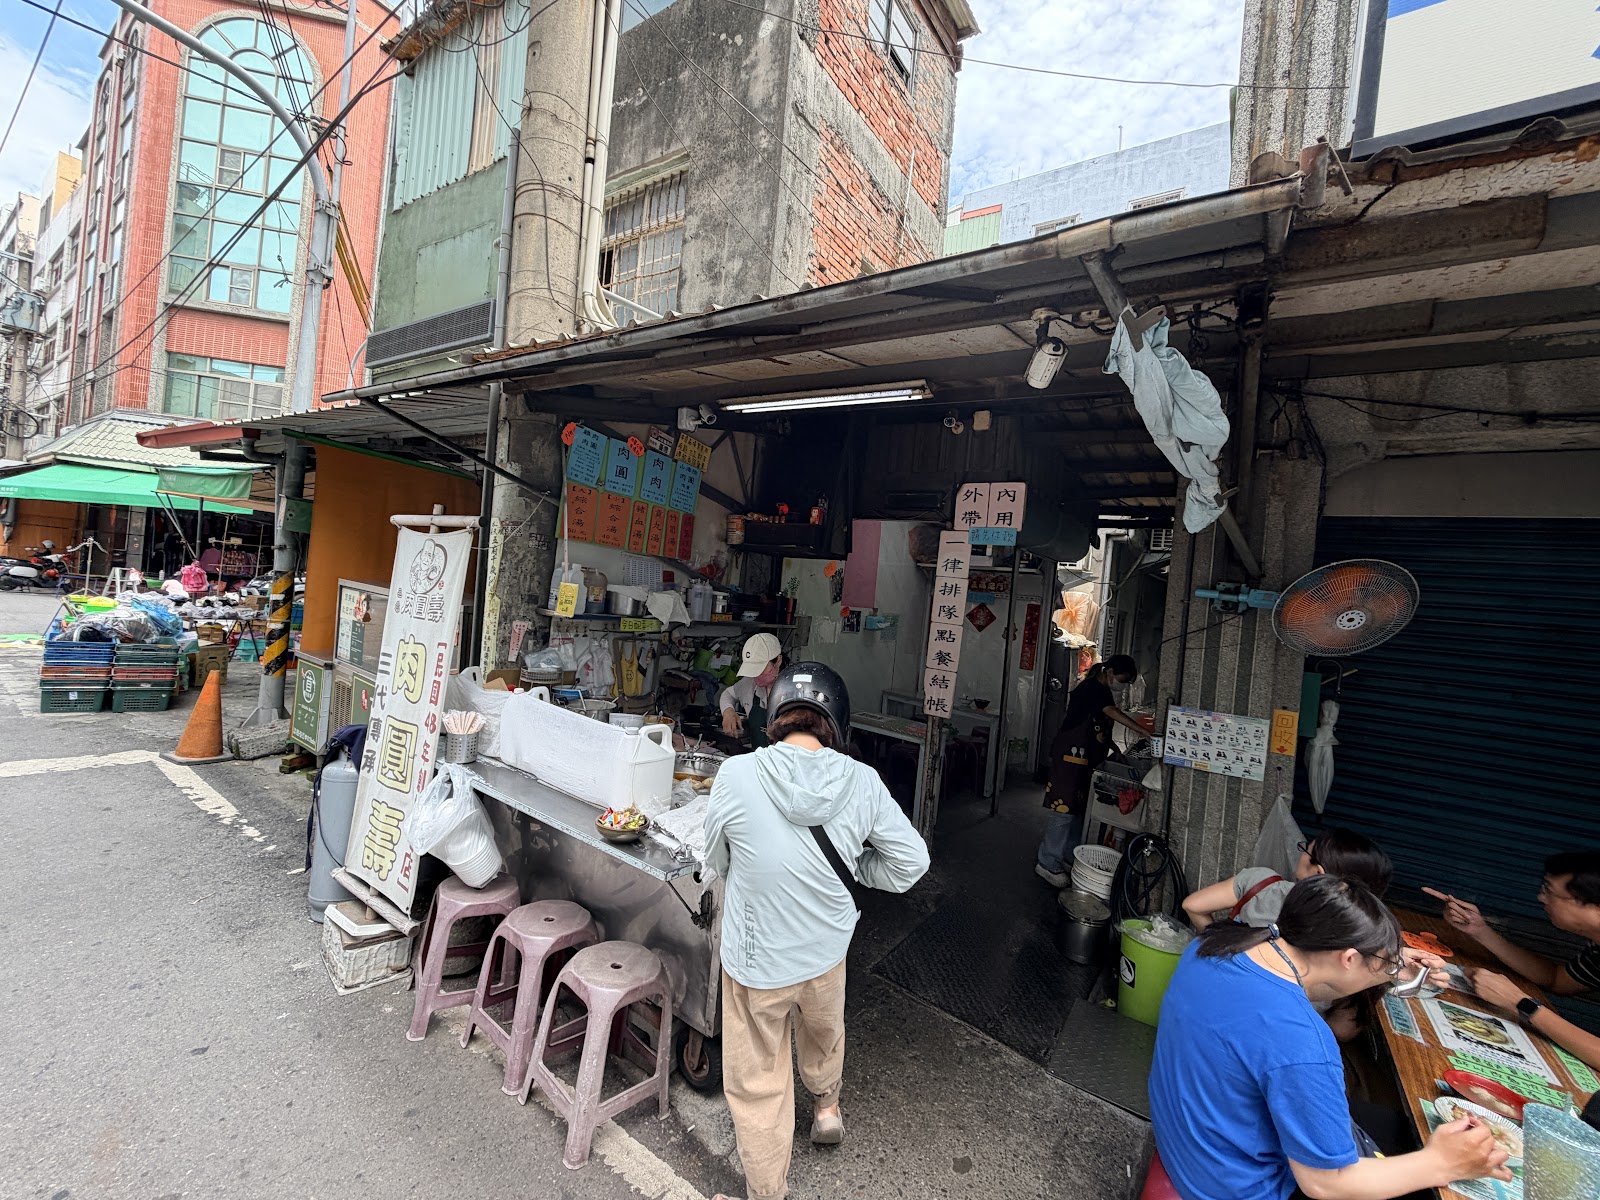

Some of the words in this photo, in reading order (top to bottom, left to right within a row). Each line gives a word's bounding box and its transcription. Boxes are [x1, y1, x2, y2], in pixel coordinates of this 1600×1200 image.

[614, 445, 631, 480] 肉圓
[650, 457, 665, 490] 肉肉
[571, 495, 588, 528] 綜合湯
[606, 503, 622, 534] 綜合湯
[961, 487, 983, 527] 外帶
[650, 508, 664, 543] 貢丸湯
[926, 539, 965, 713] 一律排隊點餐結帳
[745, 651, 751, 659] C
[361, 651, 393, 774] 三代傳承
[362, 633, 427, 881] 肉圓壽
